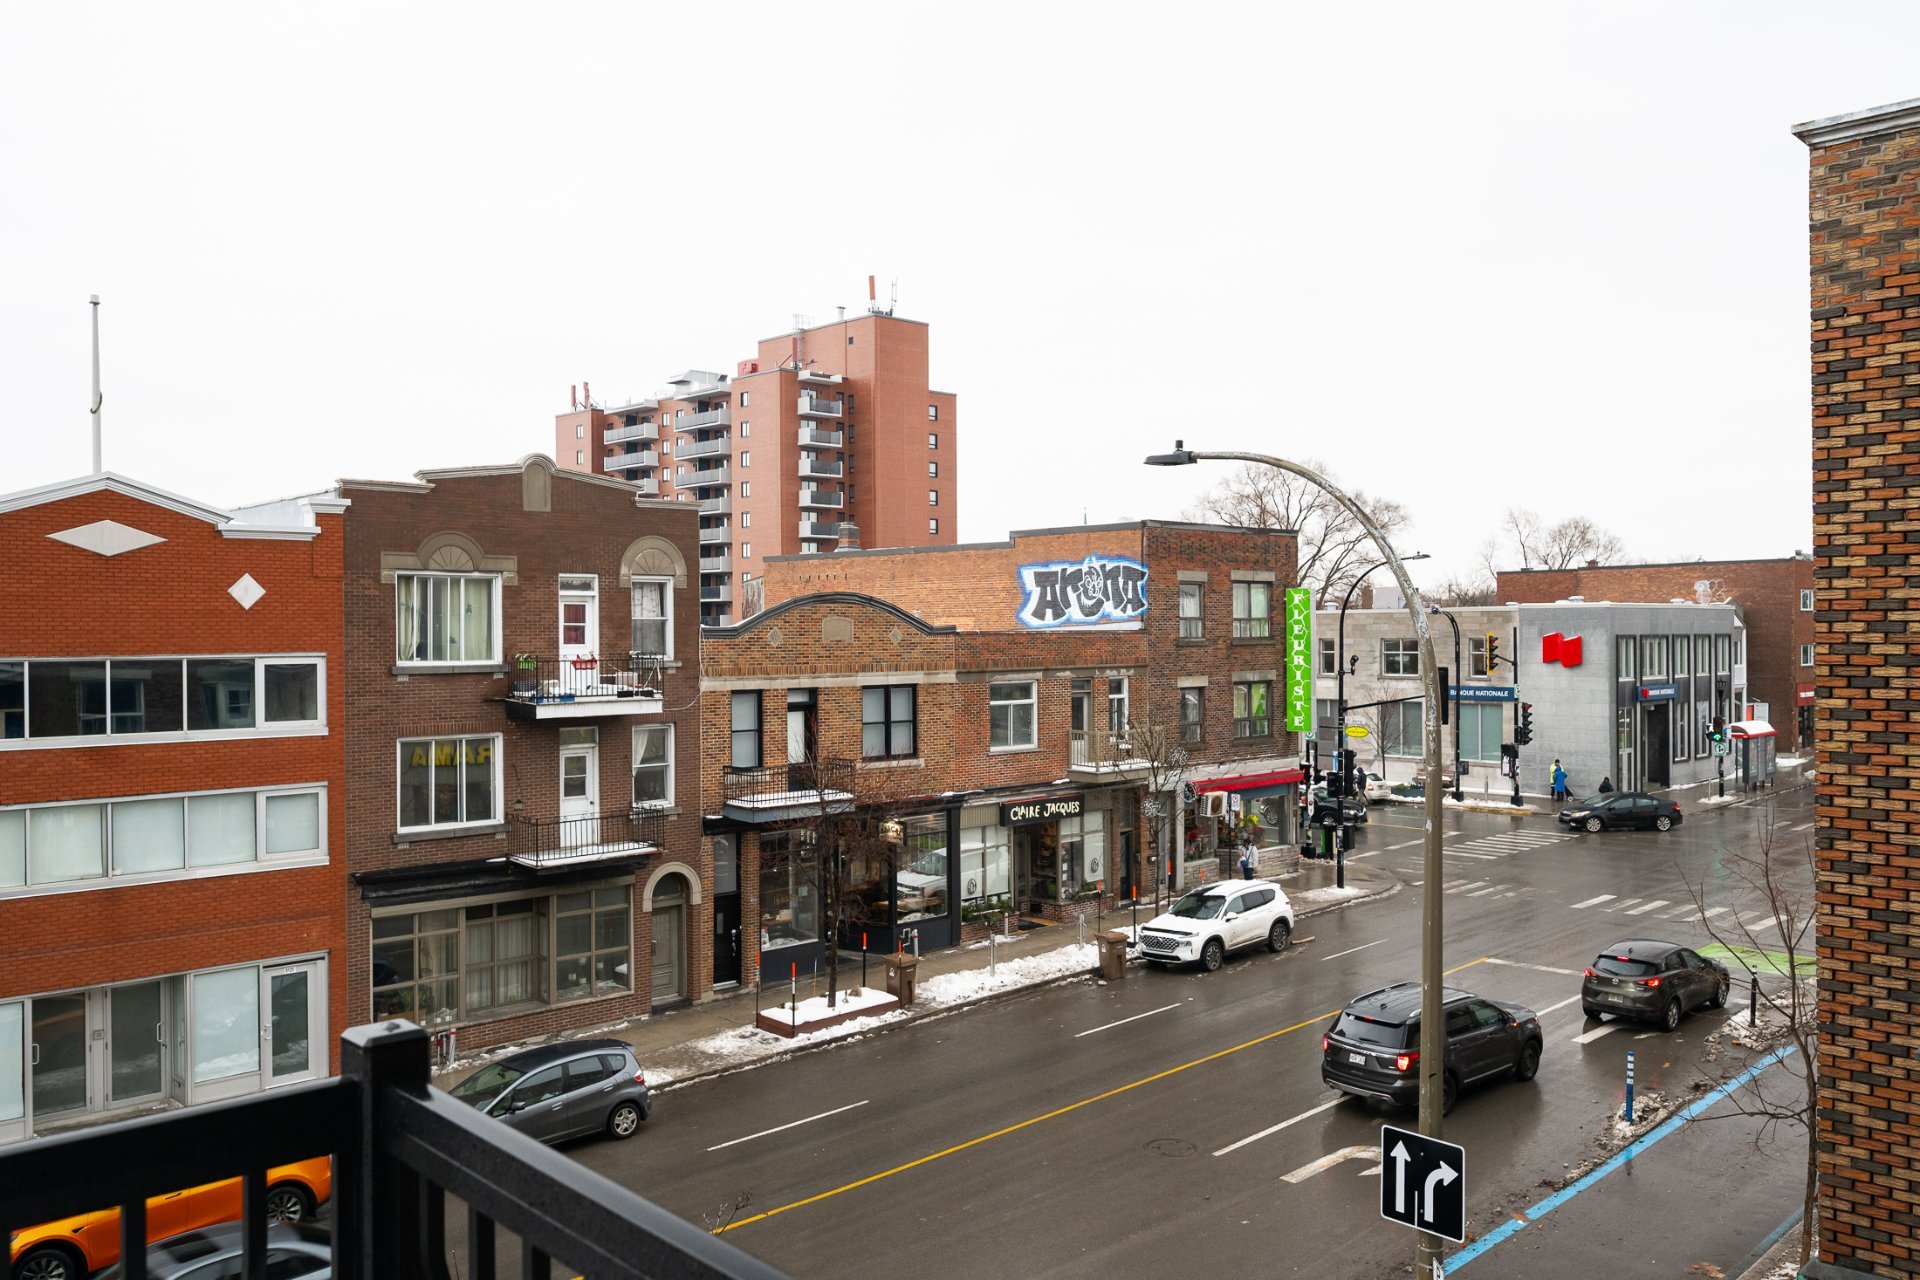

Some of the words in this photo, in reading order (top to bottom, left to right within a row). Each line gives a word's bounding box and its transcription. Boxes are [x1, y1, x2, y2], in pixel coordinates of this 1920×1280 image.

[1293, 593, 1305, 727] FLEURISTE
[1010, 805, 1041, 820] CLAIRE
[1043, 801, 1080, 817] JACQUES
